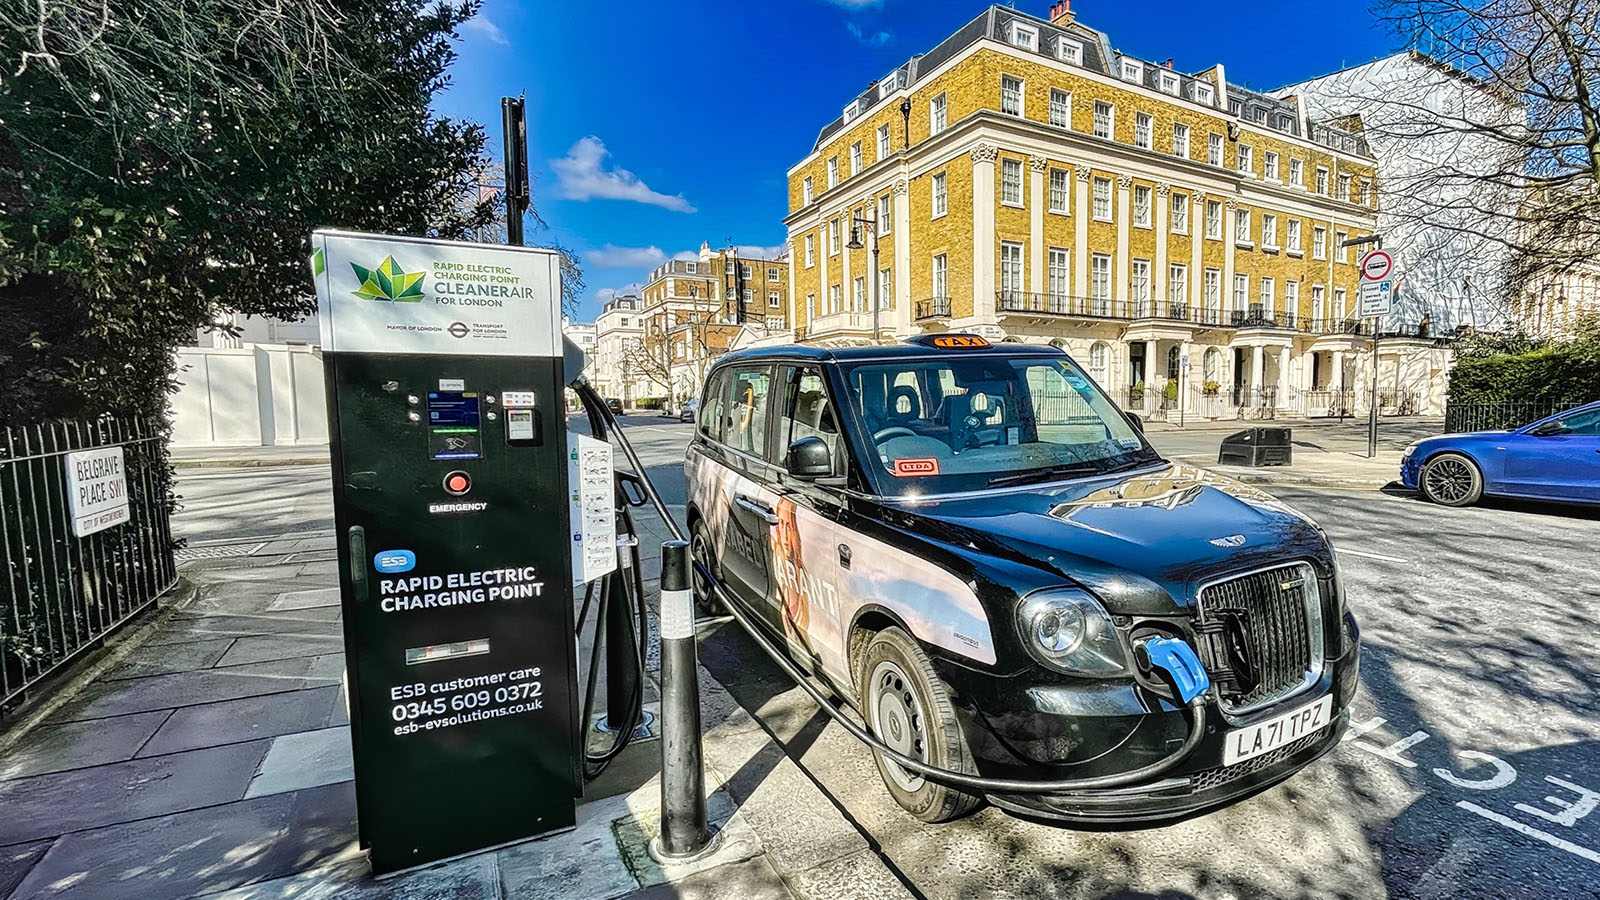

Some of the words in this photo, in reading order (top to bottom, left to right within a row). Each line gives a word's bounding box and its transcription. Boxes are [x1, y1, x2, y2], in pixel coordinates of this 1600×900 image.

[433, 261, 464, 271] RAPID
[467, 264, 512, 275] ELECTRIC
[434, 271, 488, 282] CHARGING
[490, 275, 520, 284] POINT
[435, 297, 456, 305] FOR
[459, 298, 502, 307] LONDON
[940, 338, 985, 346] TAXI
[76, 456, 119, 481] BELGRAVE
[80, 482, 107, 507] PLACE
[109, 478, 125, 499] SW1
[429, 502, 487, 513] EMERGENCY
[381, 556, 408, 567] ESB
[380, 576, 442, 595] RAPID
[447, 566, 536, 589] ELECTRIC
[381, 588, 485, 613] CHARGING
[488, 582, 545, 601] POINT
[391, 683, 426, 700] ESB
[430, 673, 506, 694] customer
[509, 666, 542, 681] care
[392, 697, 446, 722] 0345
[451, 689, 490, 711] 609
[495, 682, 543, 703] 0372
[393, 699, 543, 736] esb-evsolutions.co.uk
[1237, 720, 1284, 758] LA71
[1290, 702, 1323, 737] TPZ
